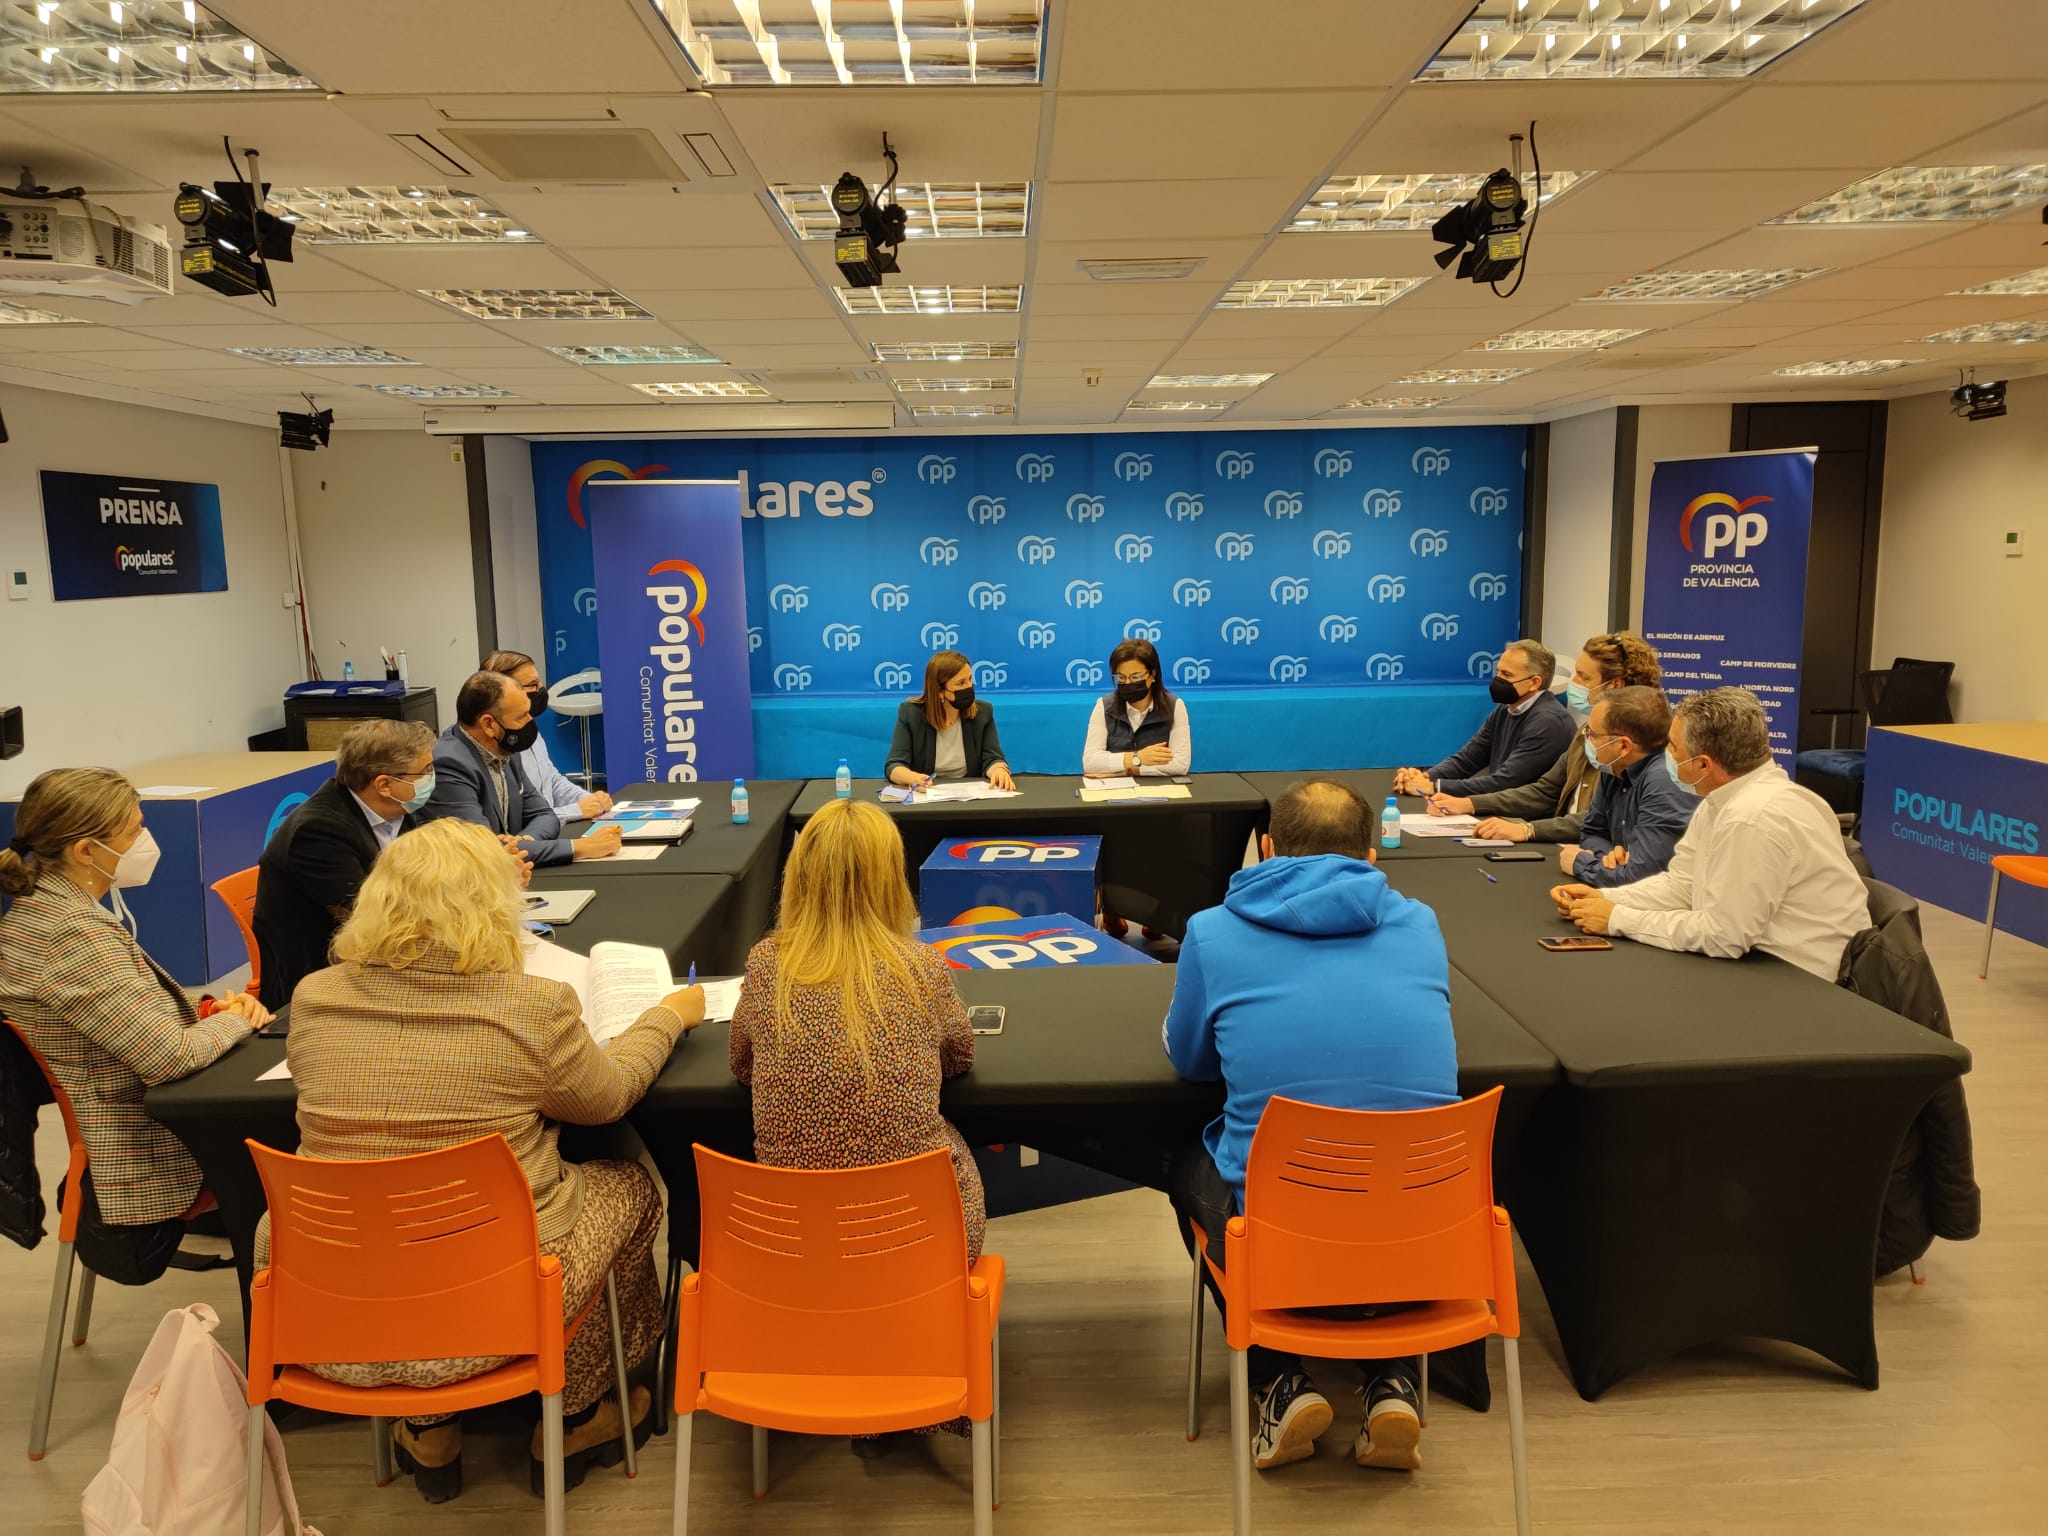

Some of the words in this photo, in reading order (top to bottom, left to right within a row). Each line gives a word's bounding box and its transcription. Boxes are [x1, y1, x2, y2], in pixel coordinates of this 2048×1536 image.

[738, 470, 874, 518] lares
[99, 498, 183, 525] PRENSA
[121, 550, 174, 571] populares
[1690, 564, 1754, 574] PROVINCIA
[1683, 578, 1698, 588] DE
[1700, 578, 1760, 588] VALENCIA
[1656, 632, 1682, 641] RINCÓN
[1663, 652, 1701, 660] SERRANOS
[1754, 661, 1797, 670] MORVEDRE
[646, 586, 704, 782] populare
[640, 665, 655, 744] Comunitat
[1760, 700, 1782, 708] UDAD
[1894, 787, 2039, 854] POPULARES
[1892, 822, 1956, 854] Comunitat
